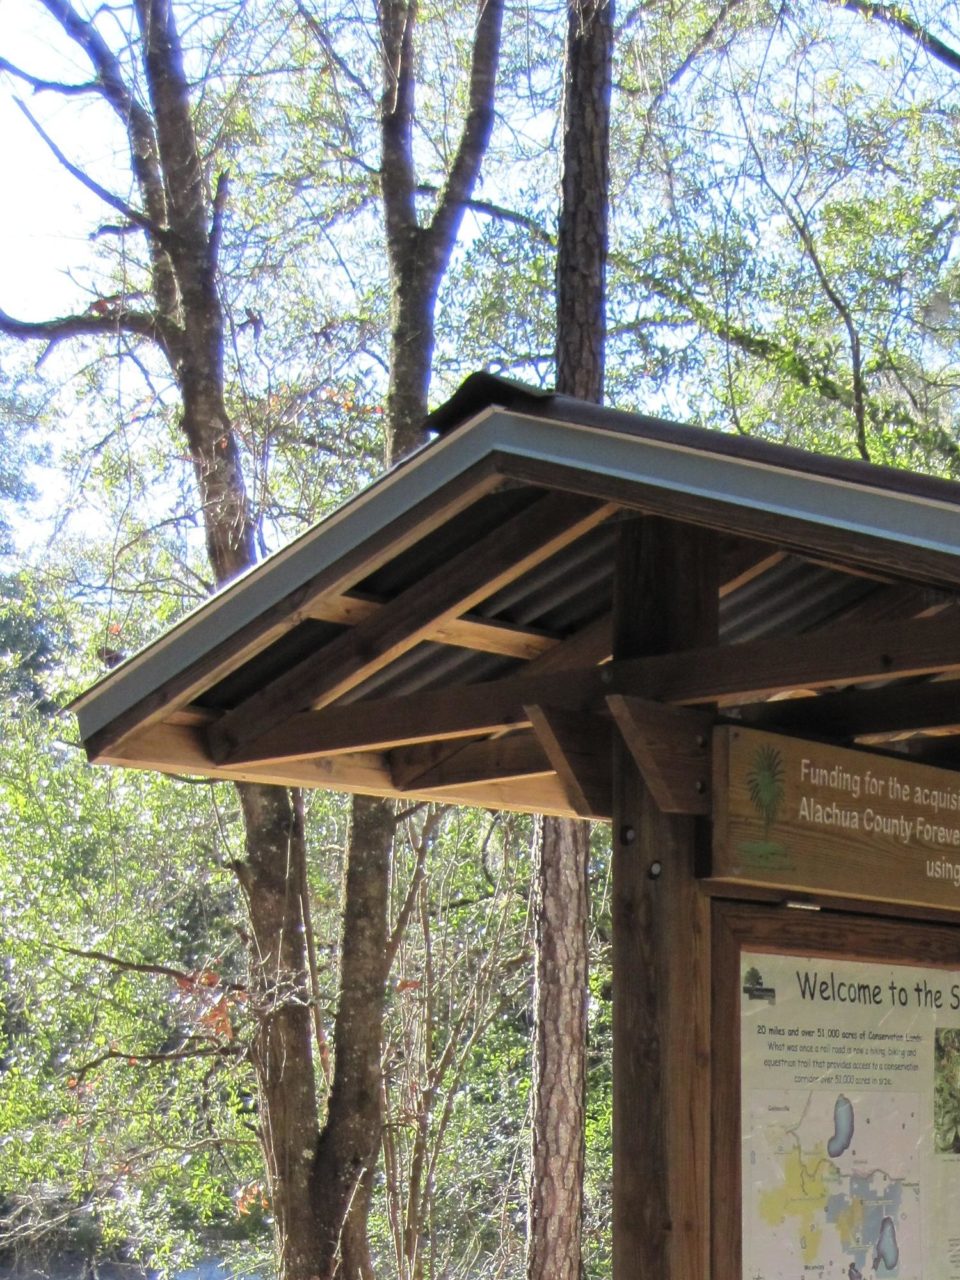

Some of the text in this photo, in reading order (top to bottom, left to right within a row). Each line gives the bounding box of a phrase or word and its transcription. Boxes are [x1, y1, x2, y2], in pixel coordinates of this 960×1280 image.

[800, 759, 860, 798] Funding
[864, 771, 885, 796] for
[888, 776, 910, 800] the
[799, 797, 859, 829] Alachua
[863, 808, 913, 843] County
[926, 856, 960, 887] using
[796, 970, 883, 1005] Welcome
[888, 979, 908, 1007] to
[914, 979, 942, 1009] the
[757, 1025, 766, 1035] 20
[769, 1026, 785, 1036] miles
[788, 1027, 799, 1036] and
[801, 1029, 815, 1037] over
[842, 1031, 857, 1040] acres
[868, 1031, 903, 1041] Conservation
[768, 1041, 785, 1051] What
[787, 1044, 798, 1052] was
